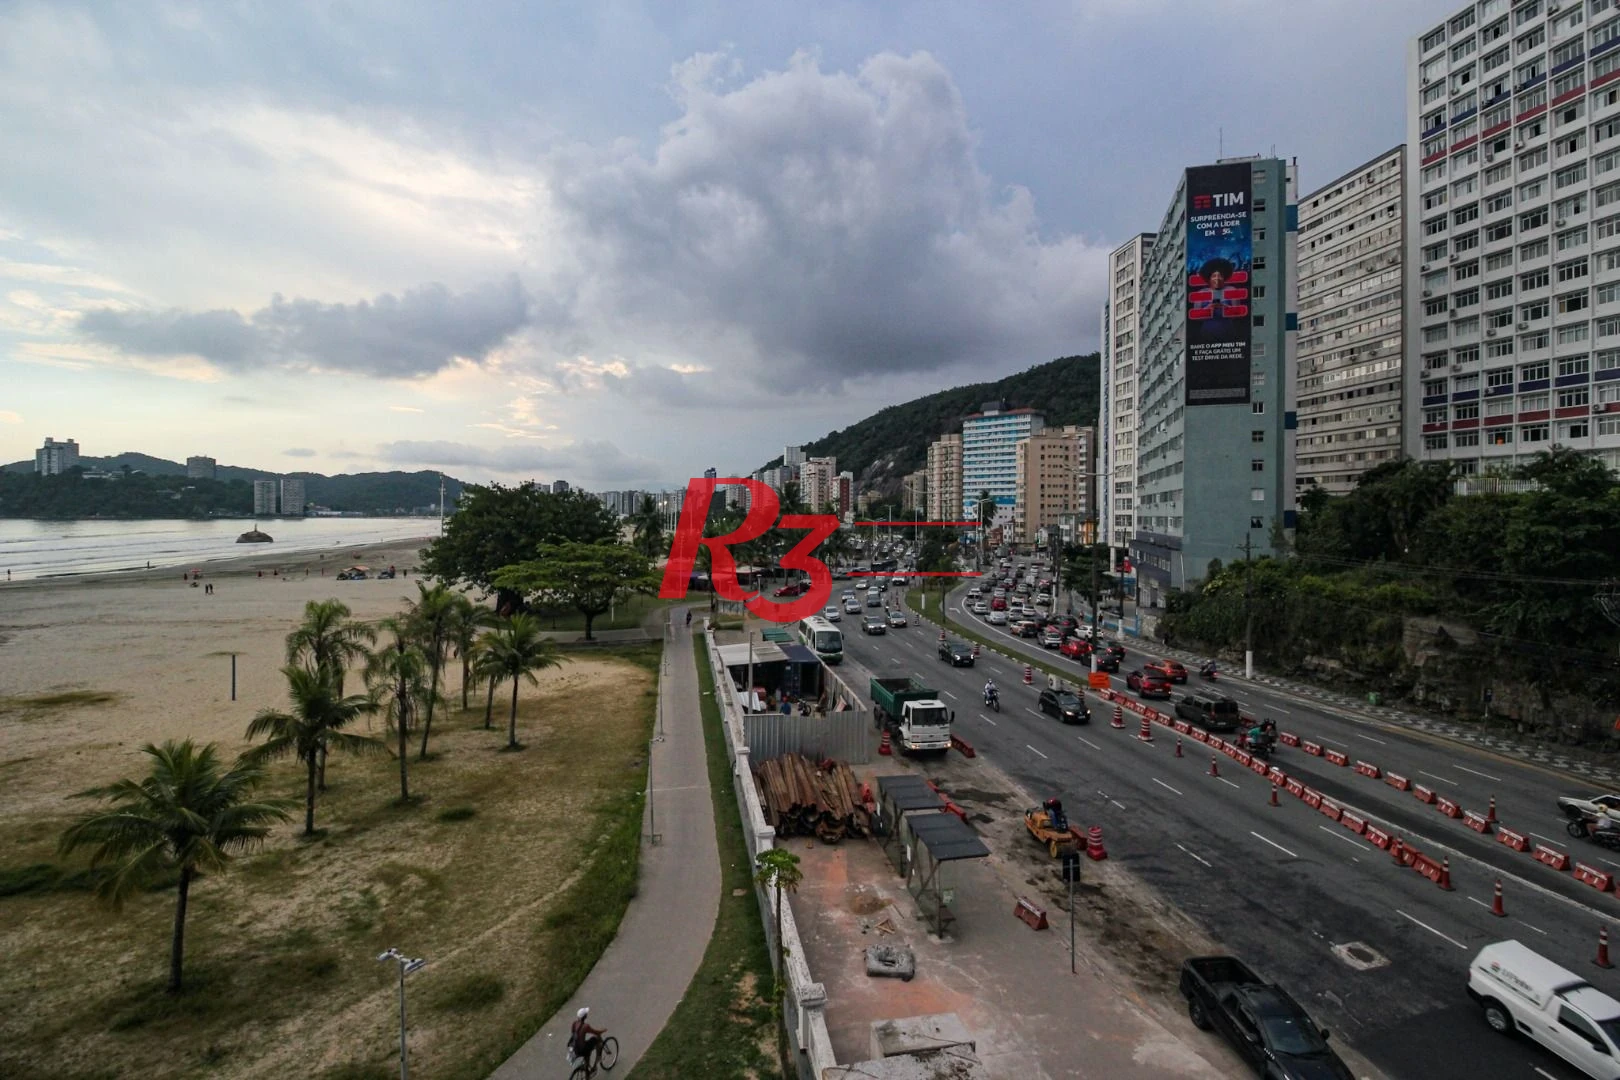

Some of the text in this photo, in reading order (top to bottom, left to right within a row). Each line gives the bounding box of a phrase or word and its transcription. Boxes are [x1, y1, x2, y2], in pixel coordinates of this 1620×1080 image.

[1213, 192, 1244, 207] TIM
[1190, 211, 1247, 222] SURPREENDA-SE
[1196, 222, 1212, 230] COM
